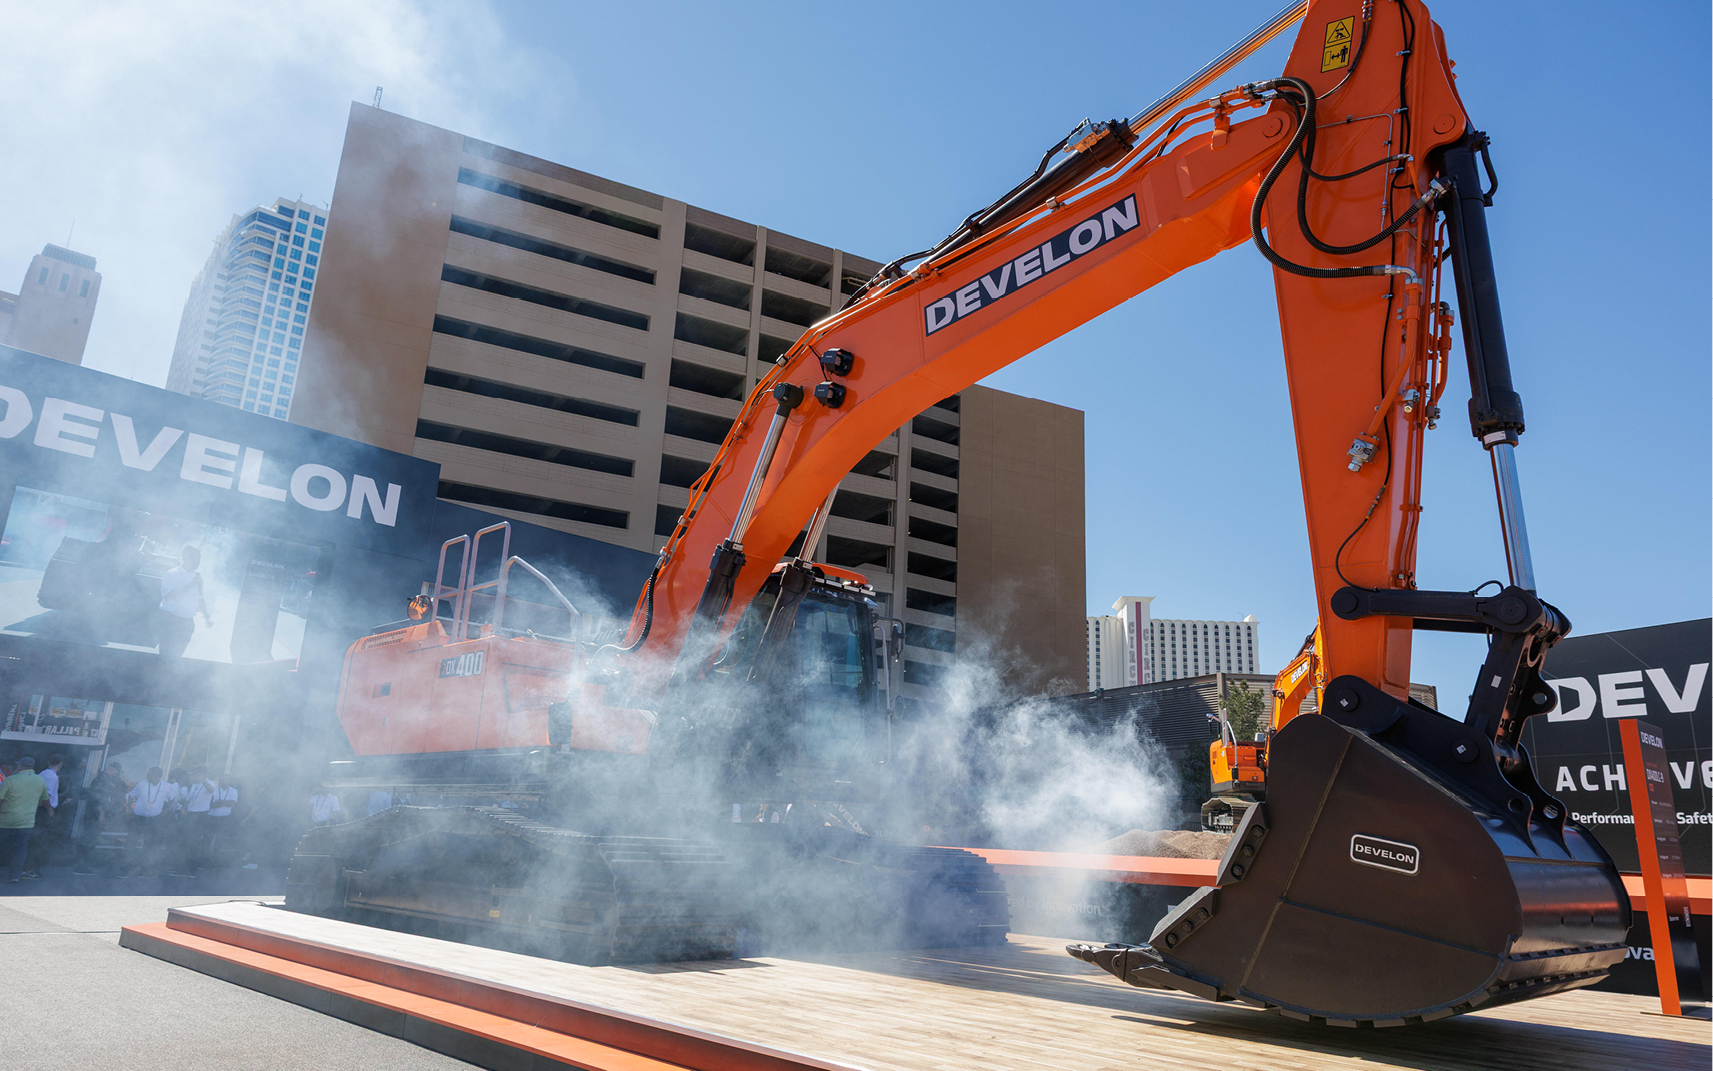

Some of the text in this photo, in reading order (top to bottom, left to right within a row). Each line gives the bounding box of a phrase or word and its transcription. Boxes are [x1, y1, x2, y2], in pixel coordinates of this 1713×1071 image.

[926, 196, 1138, 334] DEVELON
[251, 559, 284, 570] DEVELON
[1640, 731, 1664, 749] DEVELON
[1355, 843, 1414, 864] DEVELON
[1027, 897, 1040, 911] by
[1042, 898, 1101, 915] Innovation
